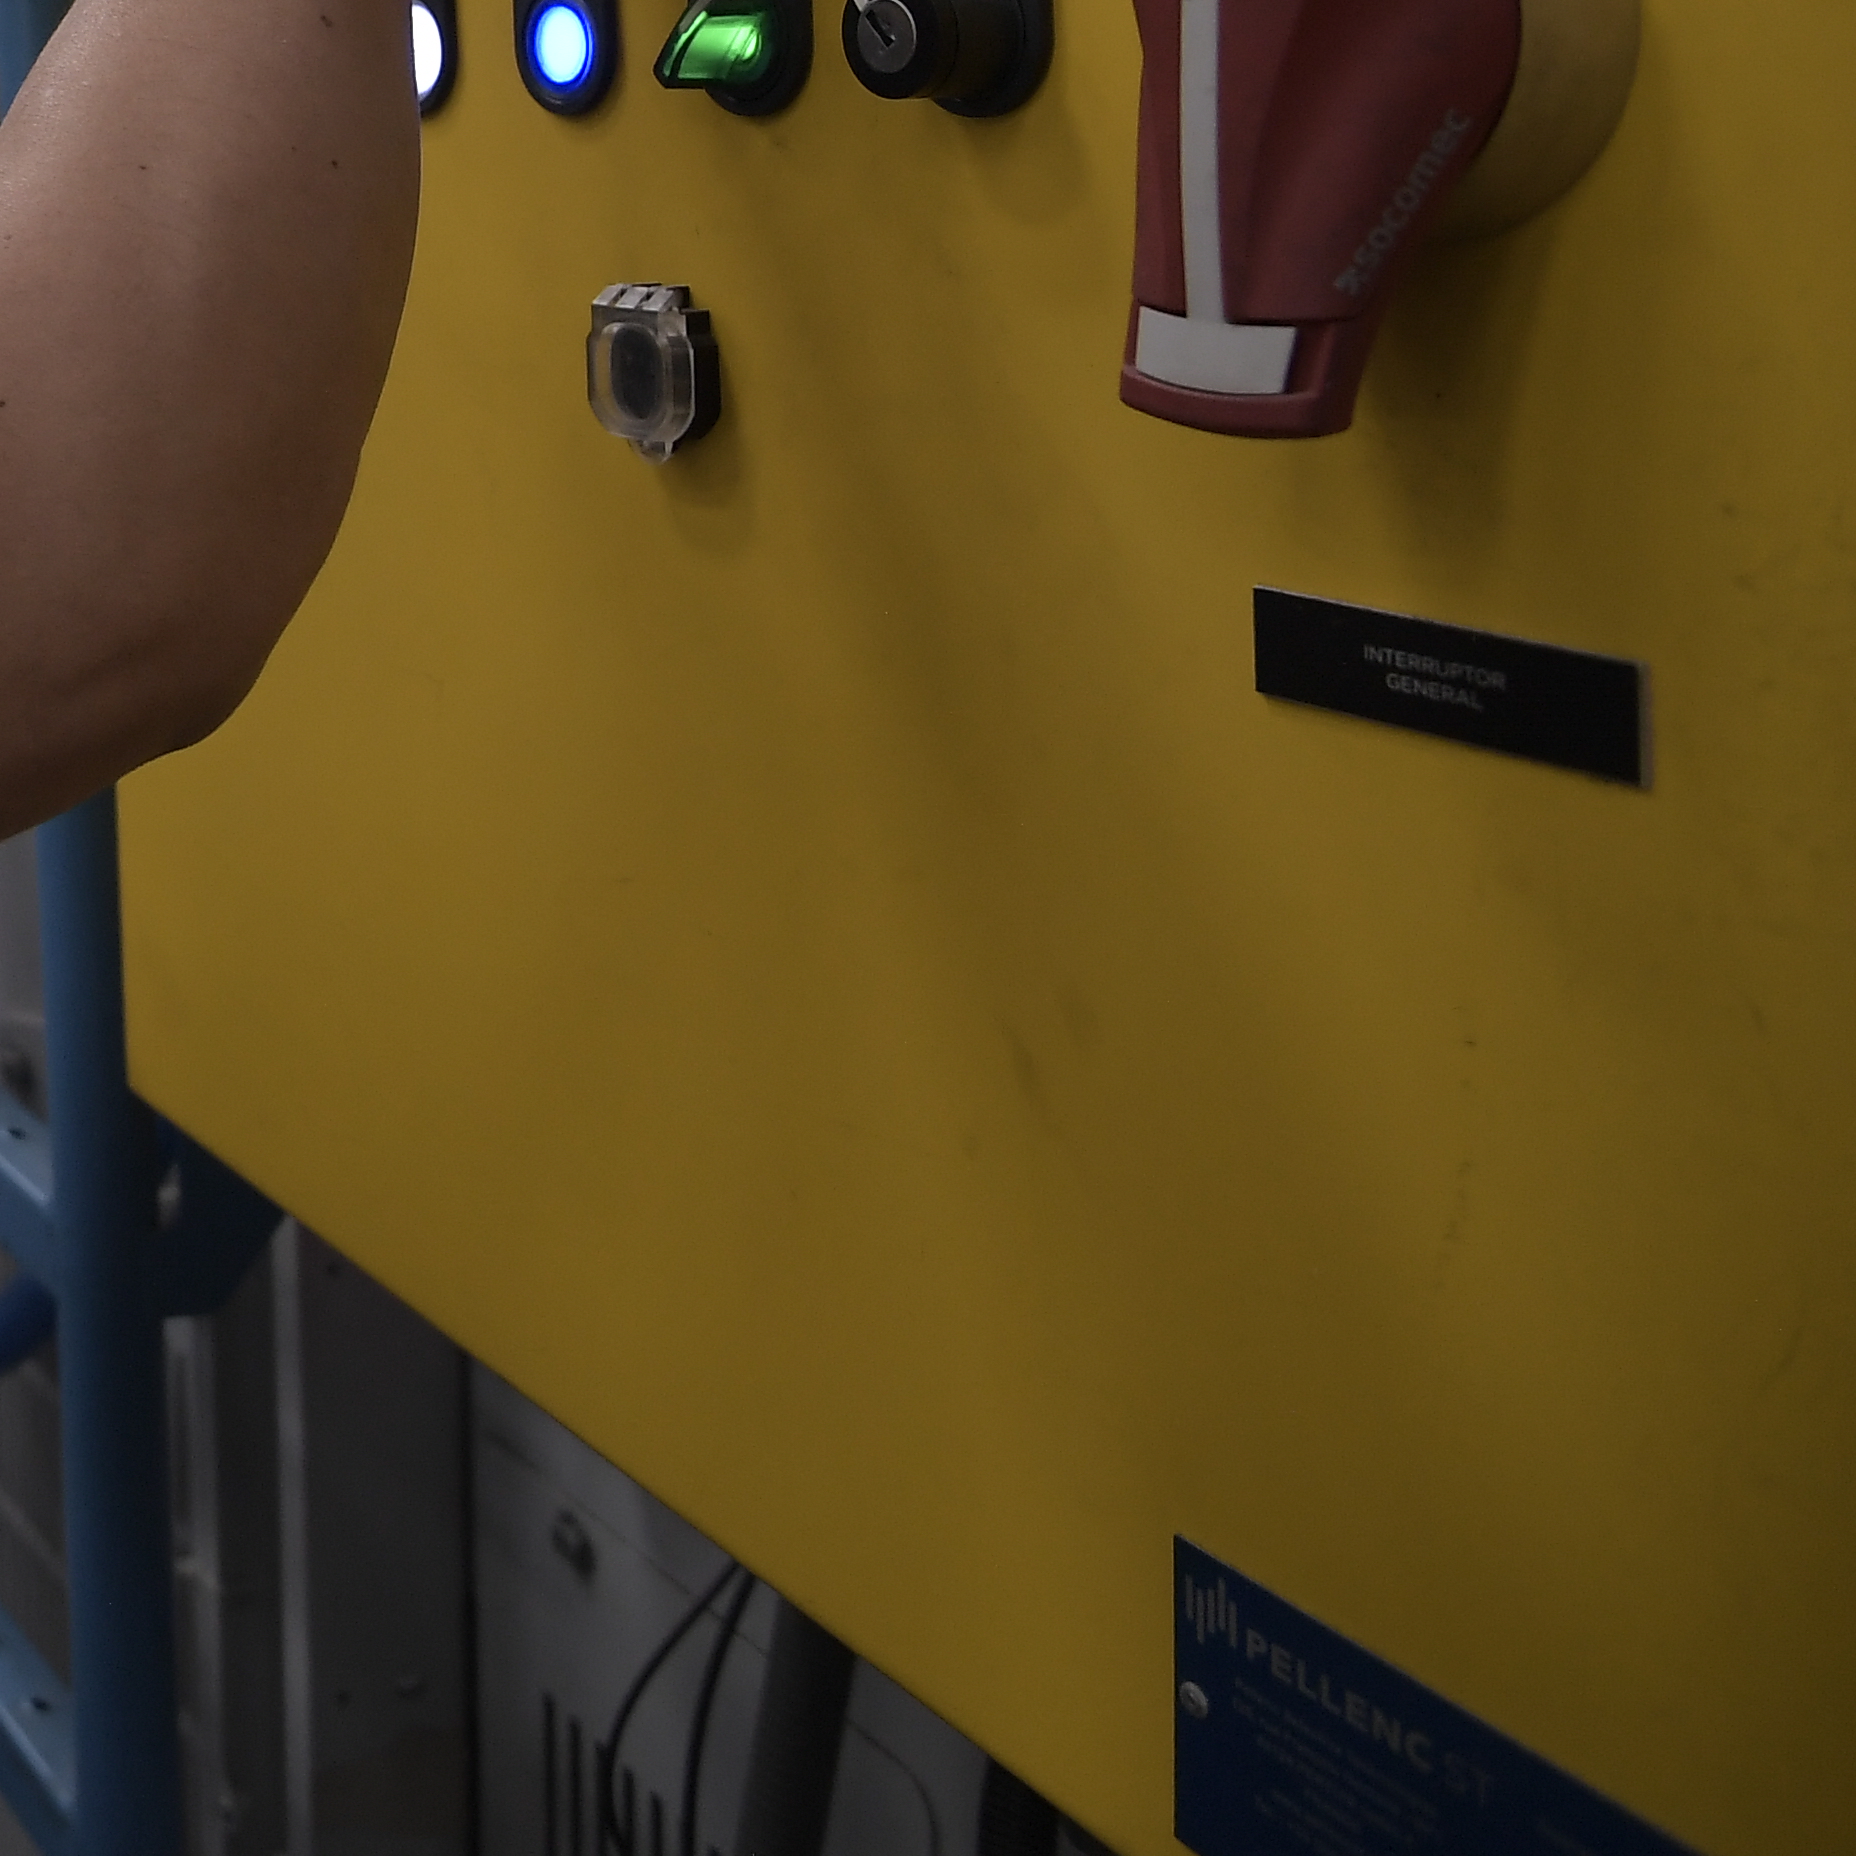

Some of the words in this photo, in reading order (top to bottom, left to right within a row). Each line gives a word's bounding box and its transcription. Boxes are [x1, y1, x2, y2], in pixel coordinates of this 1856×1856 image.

[1363, 644, 1508, 690] INTERRUPTOR
[1386, 672, 1484, 712] GENERAL
[1244, 1625, 1435, 1774] PELLENC
